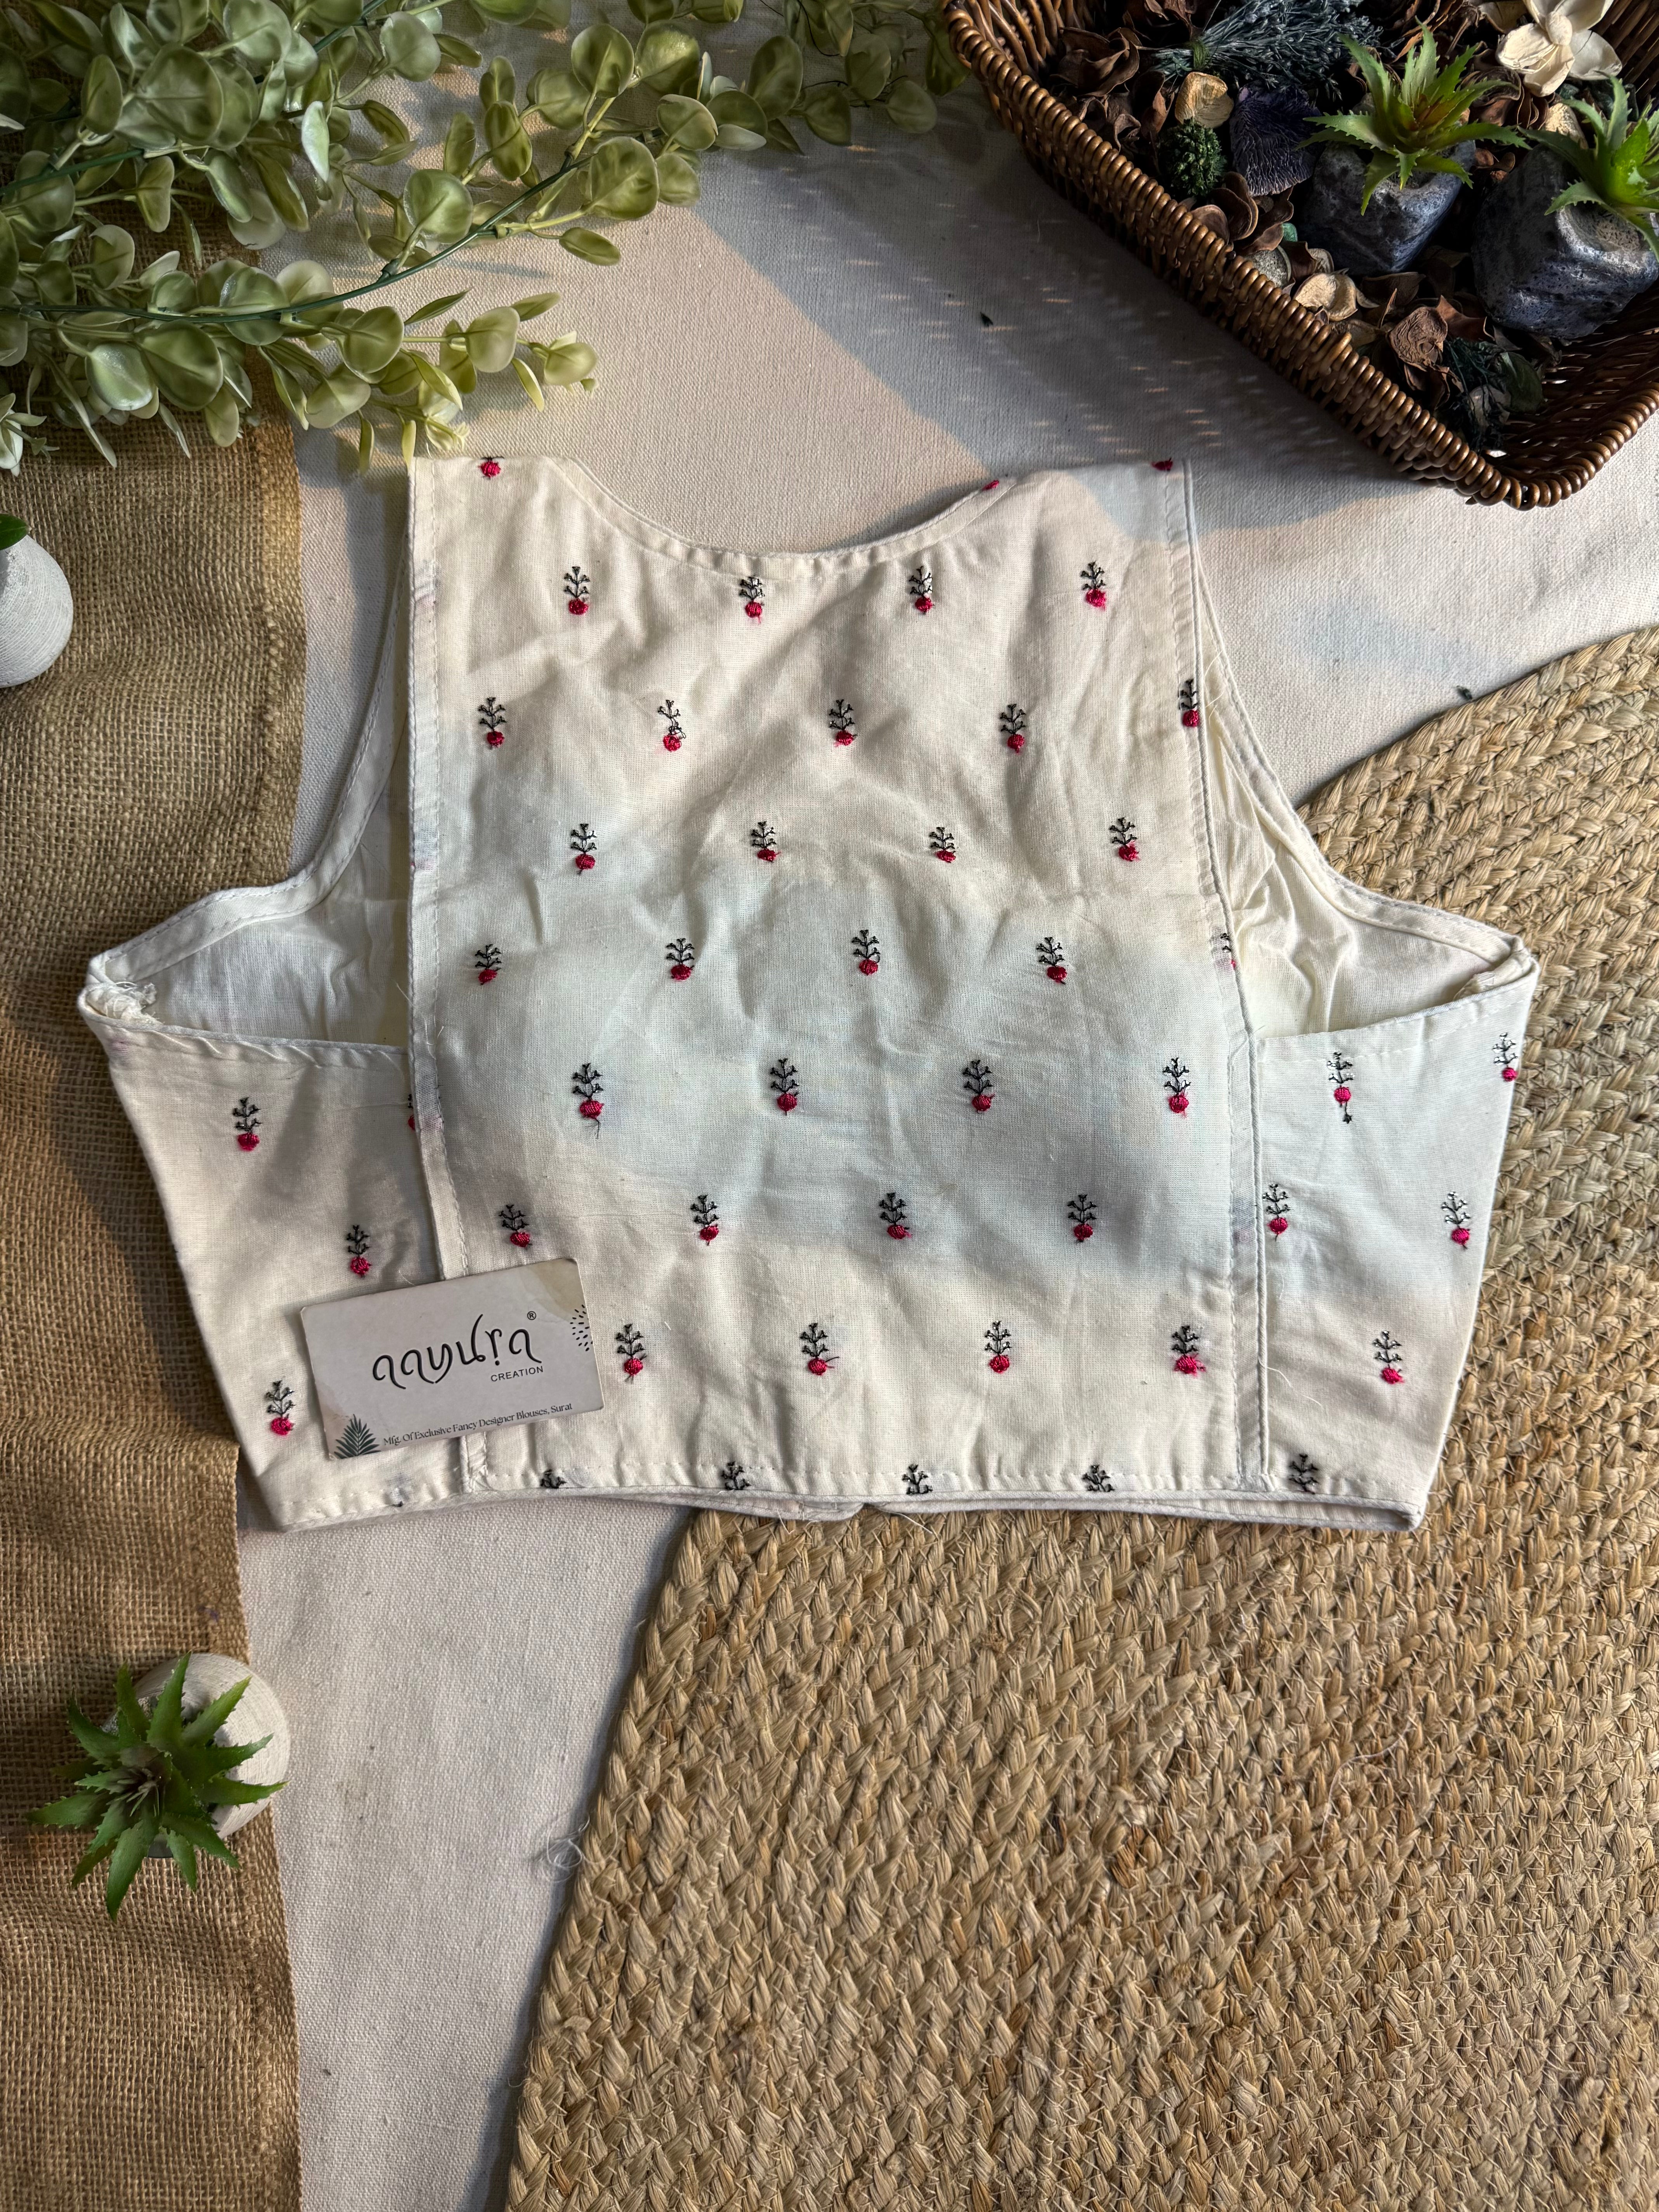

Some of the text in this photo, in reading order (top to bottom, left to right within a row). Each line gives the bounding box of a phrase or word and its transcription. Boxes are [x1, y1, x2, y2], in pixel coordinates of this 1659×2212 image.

[491, 1366, 544, 1382] CREATION
[383, 1403, 572, 1446] Mfg. Of Exclusive Fancy Designer Blouses, Surat
